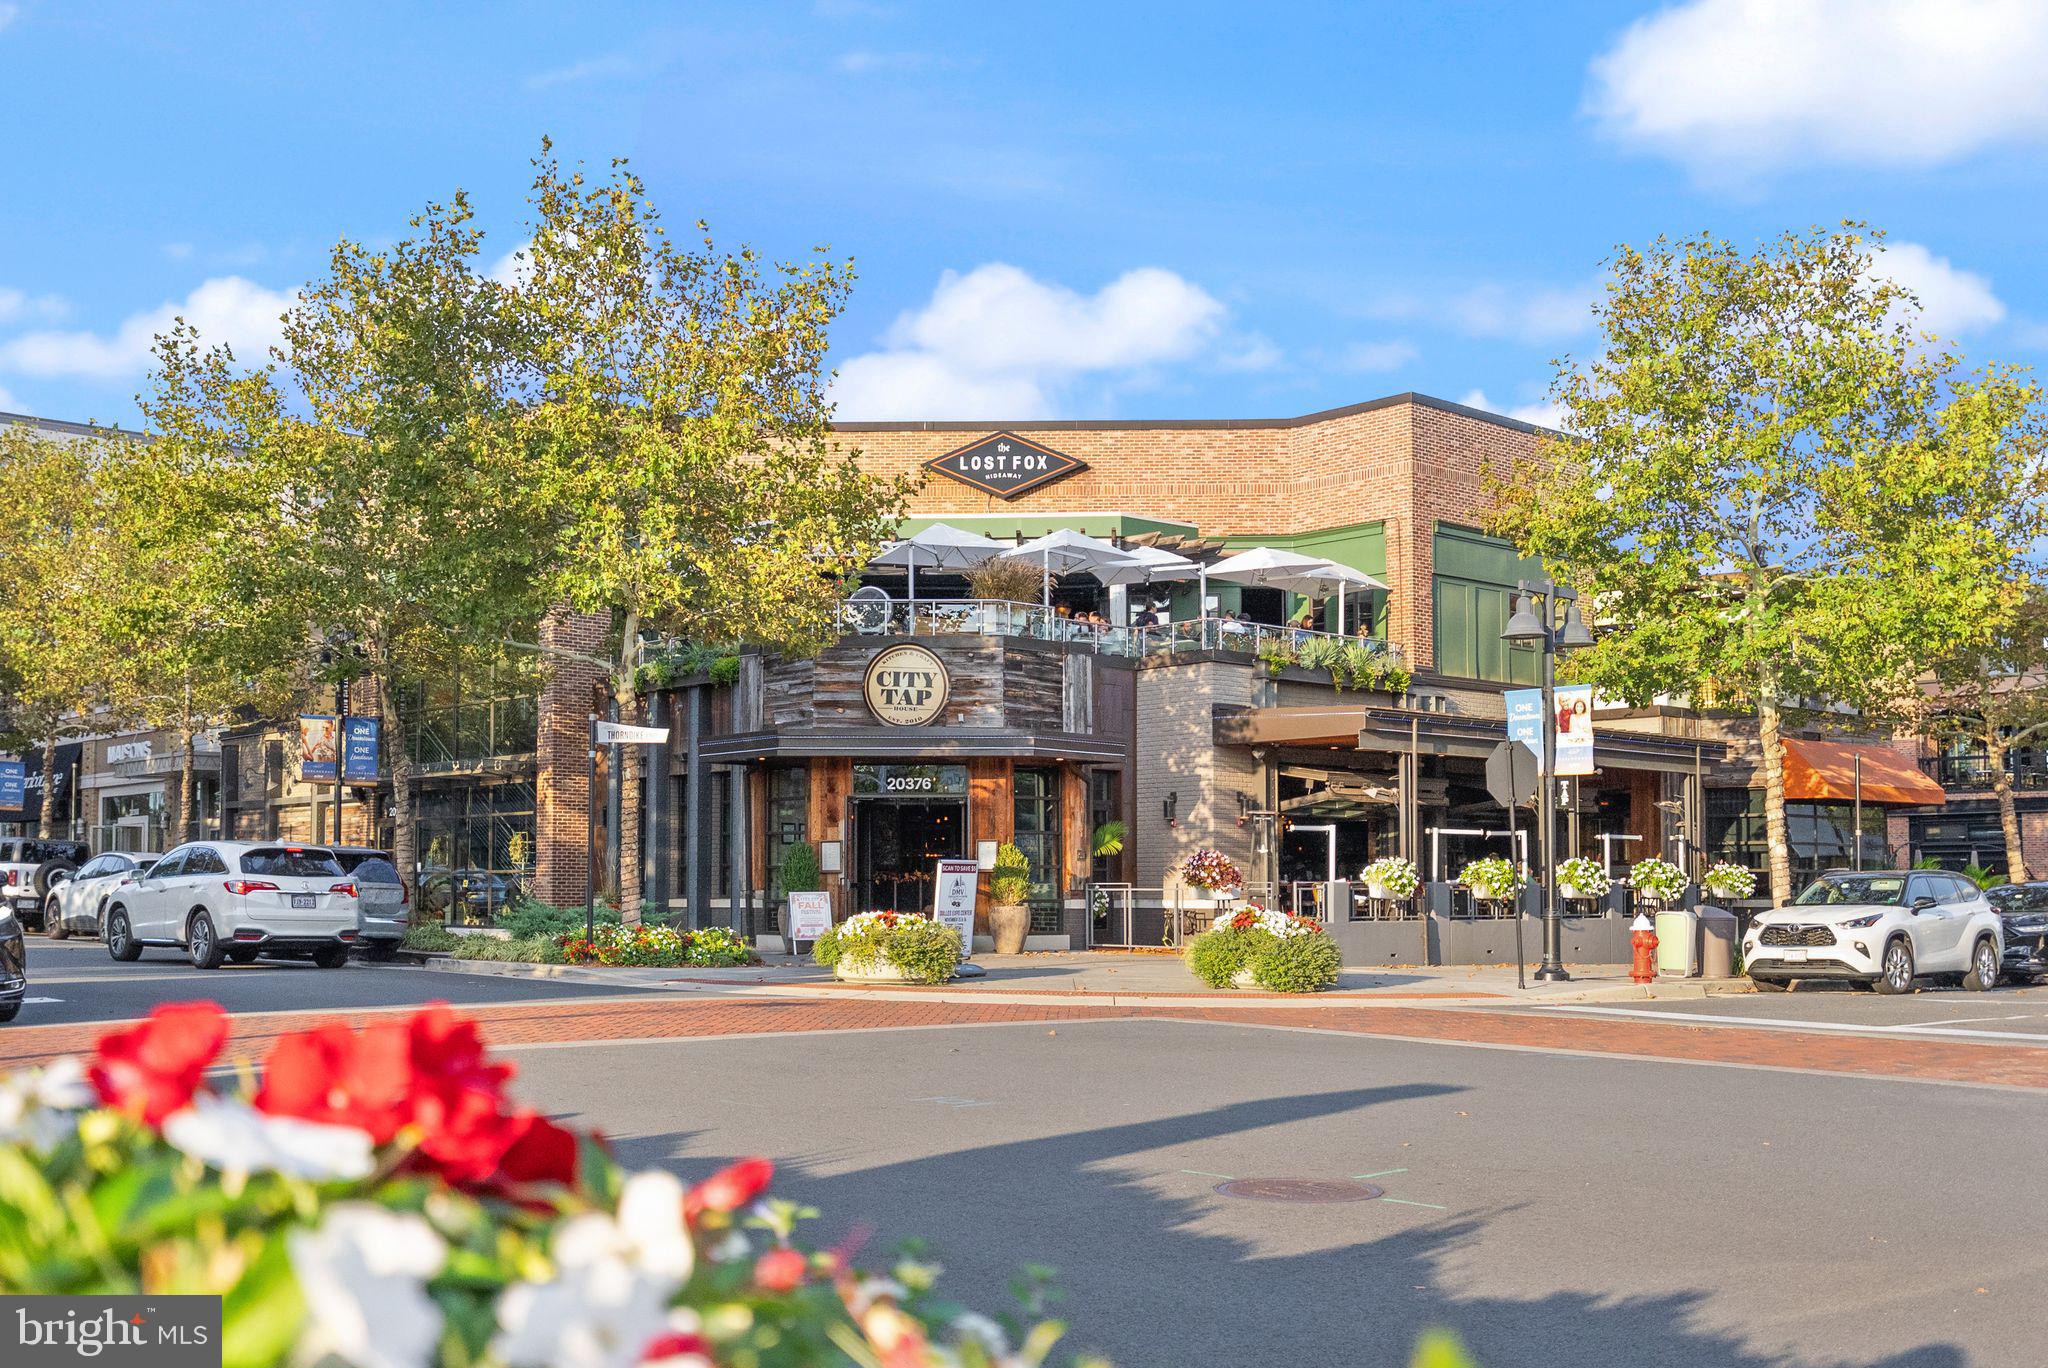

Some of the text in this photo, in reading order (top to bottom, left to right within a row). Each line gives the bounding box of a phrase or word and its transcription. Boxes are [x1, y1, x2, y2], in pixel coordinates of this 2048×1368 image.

[997, 442, 1010, 453] the
[959, 455, 1047, 470] LOST FOX
[985, 472, 1022, 480] HIDEAWAY
[881, 651, 908, 665] KITCHEN
[876, 670, 938, 688] CITY
[880, 688, 932, 706] TAP
[1515, 703, 1533, 712] ONE
[905, 716, 923, 724] 2010
[353, 727, 370, 735] ONE
[607, 730, 644, 740] THORNDIKE
[1517, 727, 1534, 736] ONE
[354, 746, 370, 754] ONE
[887, 777, 932, 790] 20376
[798, 901, 824, 909] FALL
